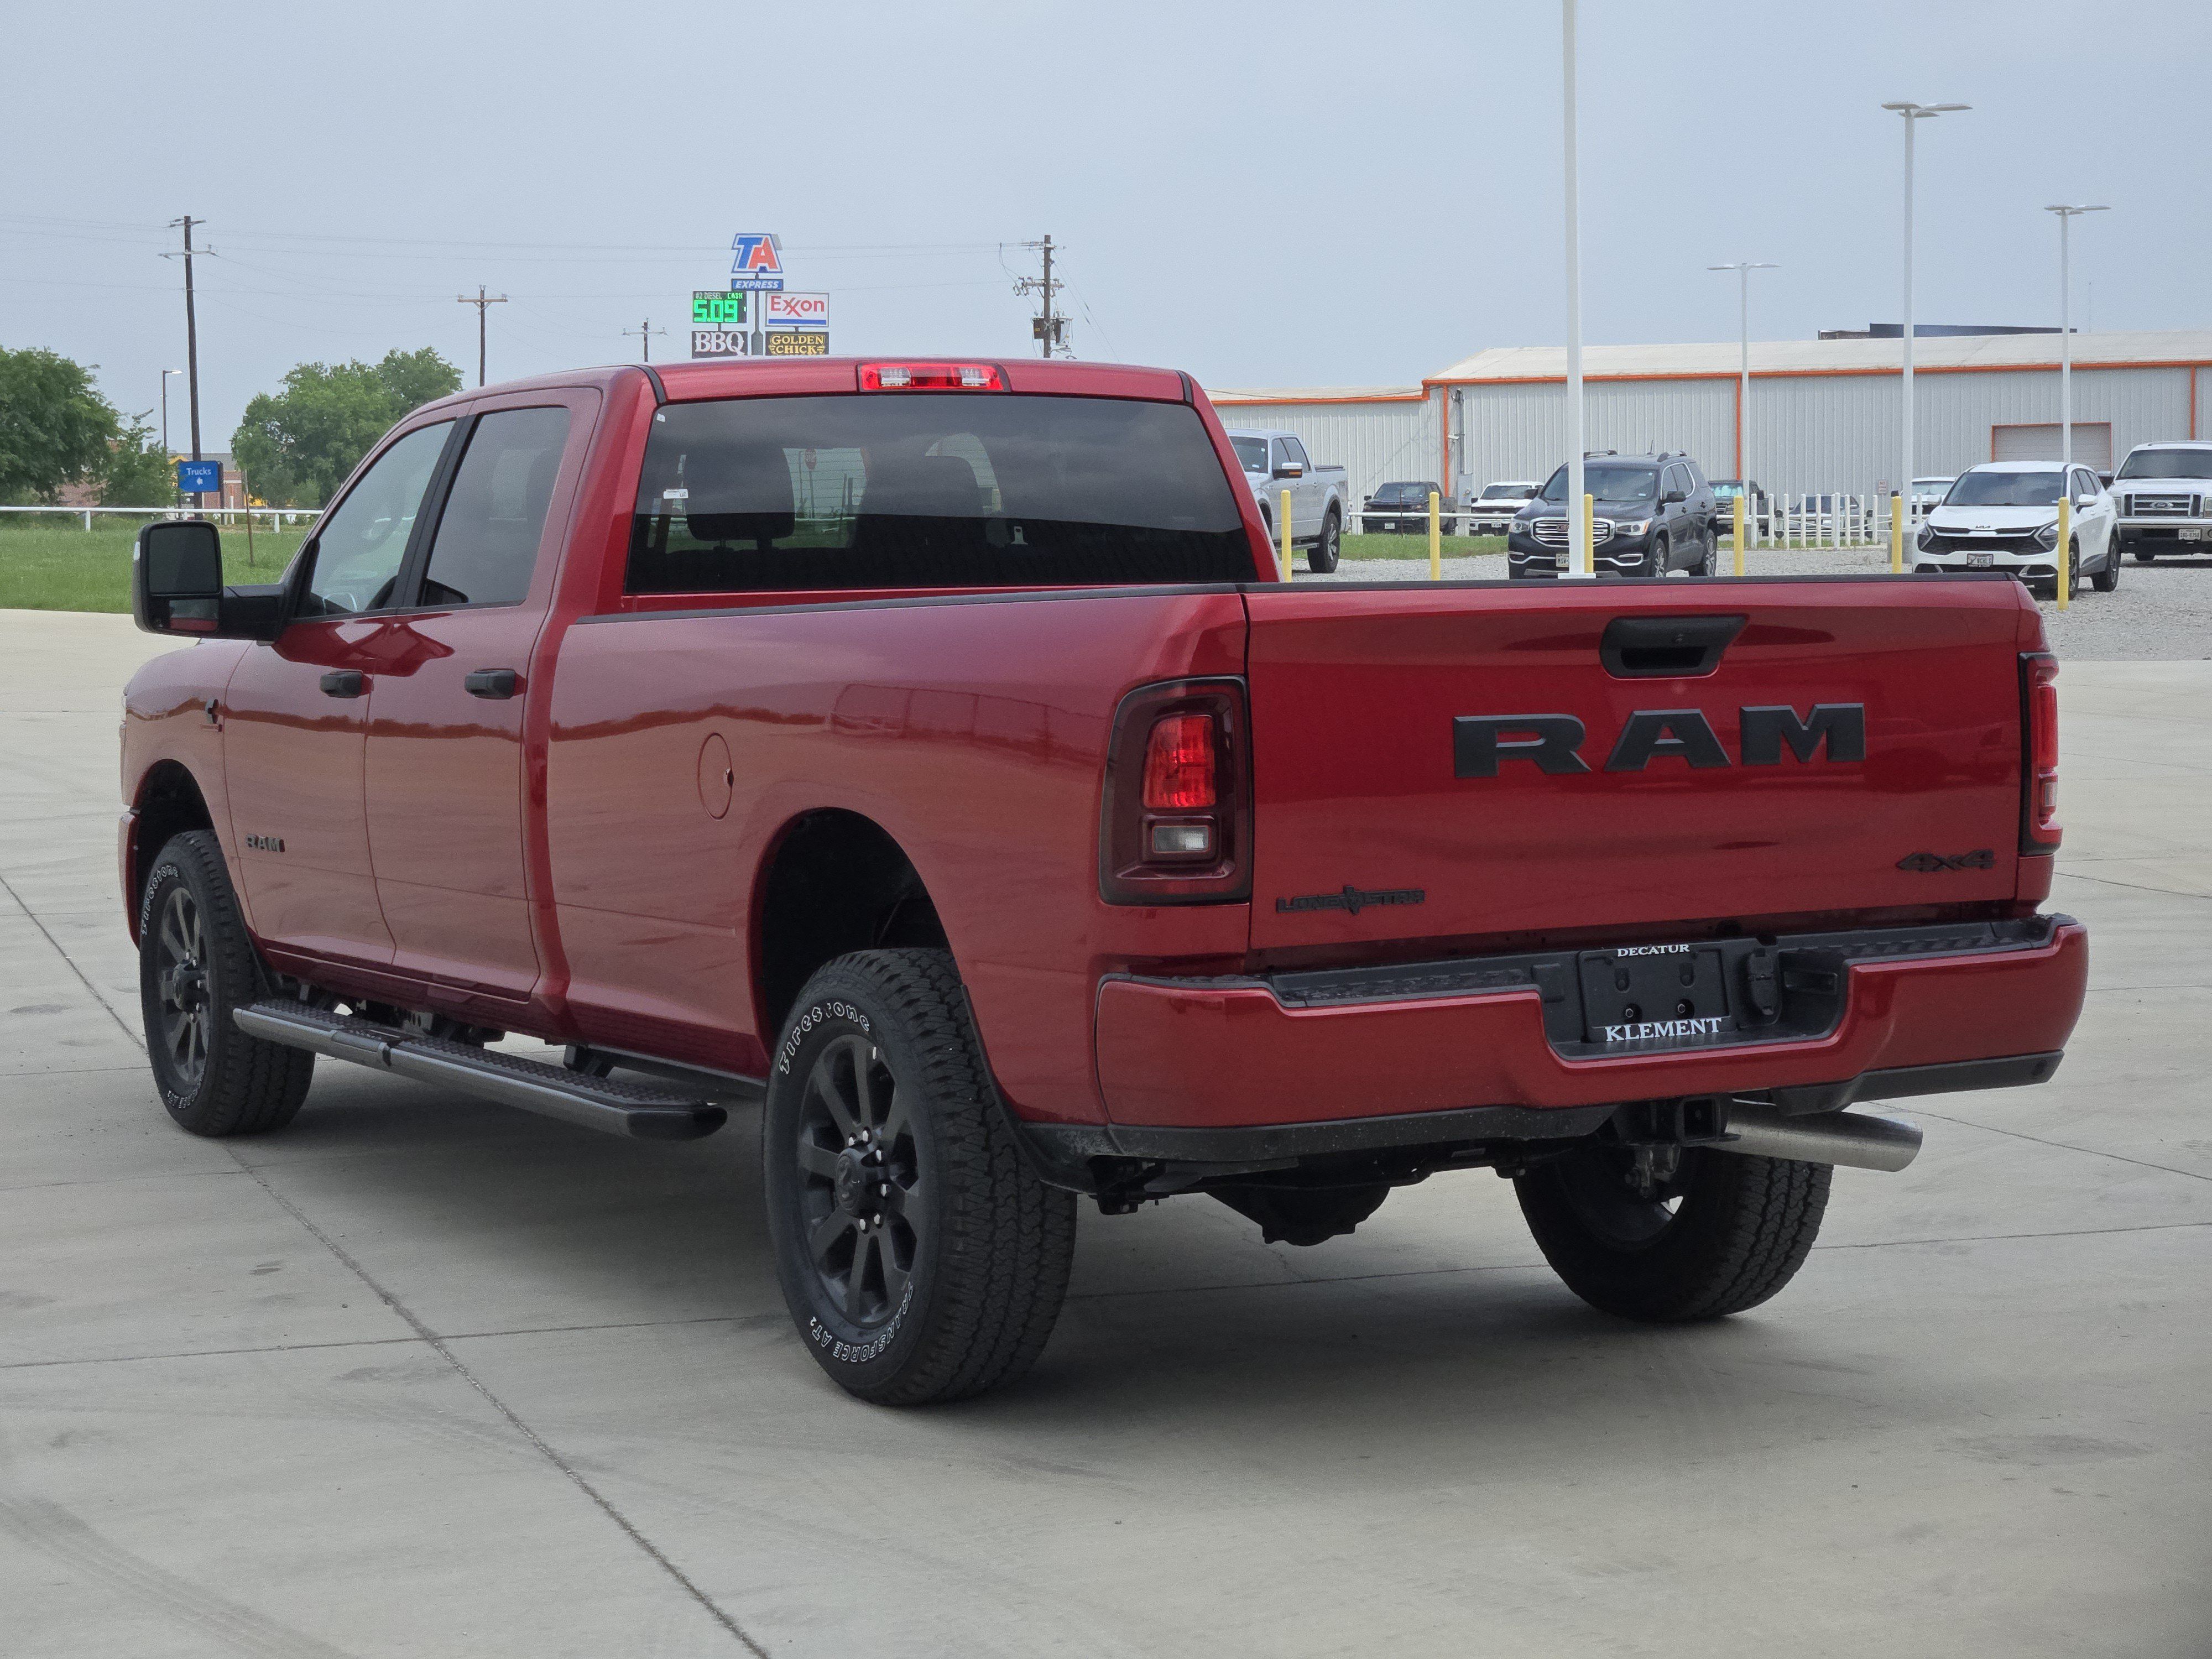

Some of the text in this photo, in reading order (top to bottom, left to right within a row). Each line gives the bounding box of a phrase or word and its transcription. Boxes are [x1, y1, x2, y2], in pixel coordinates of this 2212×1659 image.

[736, 236, 779, 269] TA
[735, 280, 779, 289] EXPRESS
[693, 300, 738, 322] 5.09
[770, 295, 825, 317] Exxon
[695, 332, 745, 356] BBQ
[771, 335, 825, 345] GOLDEN
[775, 345, 817, 354] CHICK
[186, 467, 212, 476] Trucks
[1453, 702, 1866, 778] RAM
[245, 833, 285, 853] RAM
[1276, 889, 1425, 913] LONE STAR
[1617, 943, 1691, 957] DECATUR
[1604, 1018, 1722, 1042] KLEMENT
